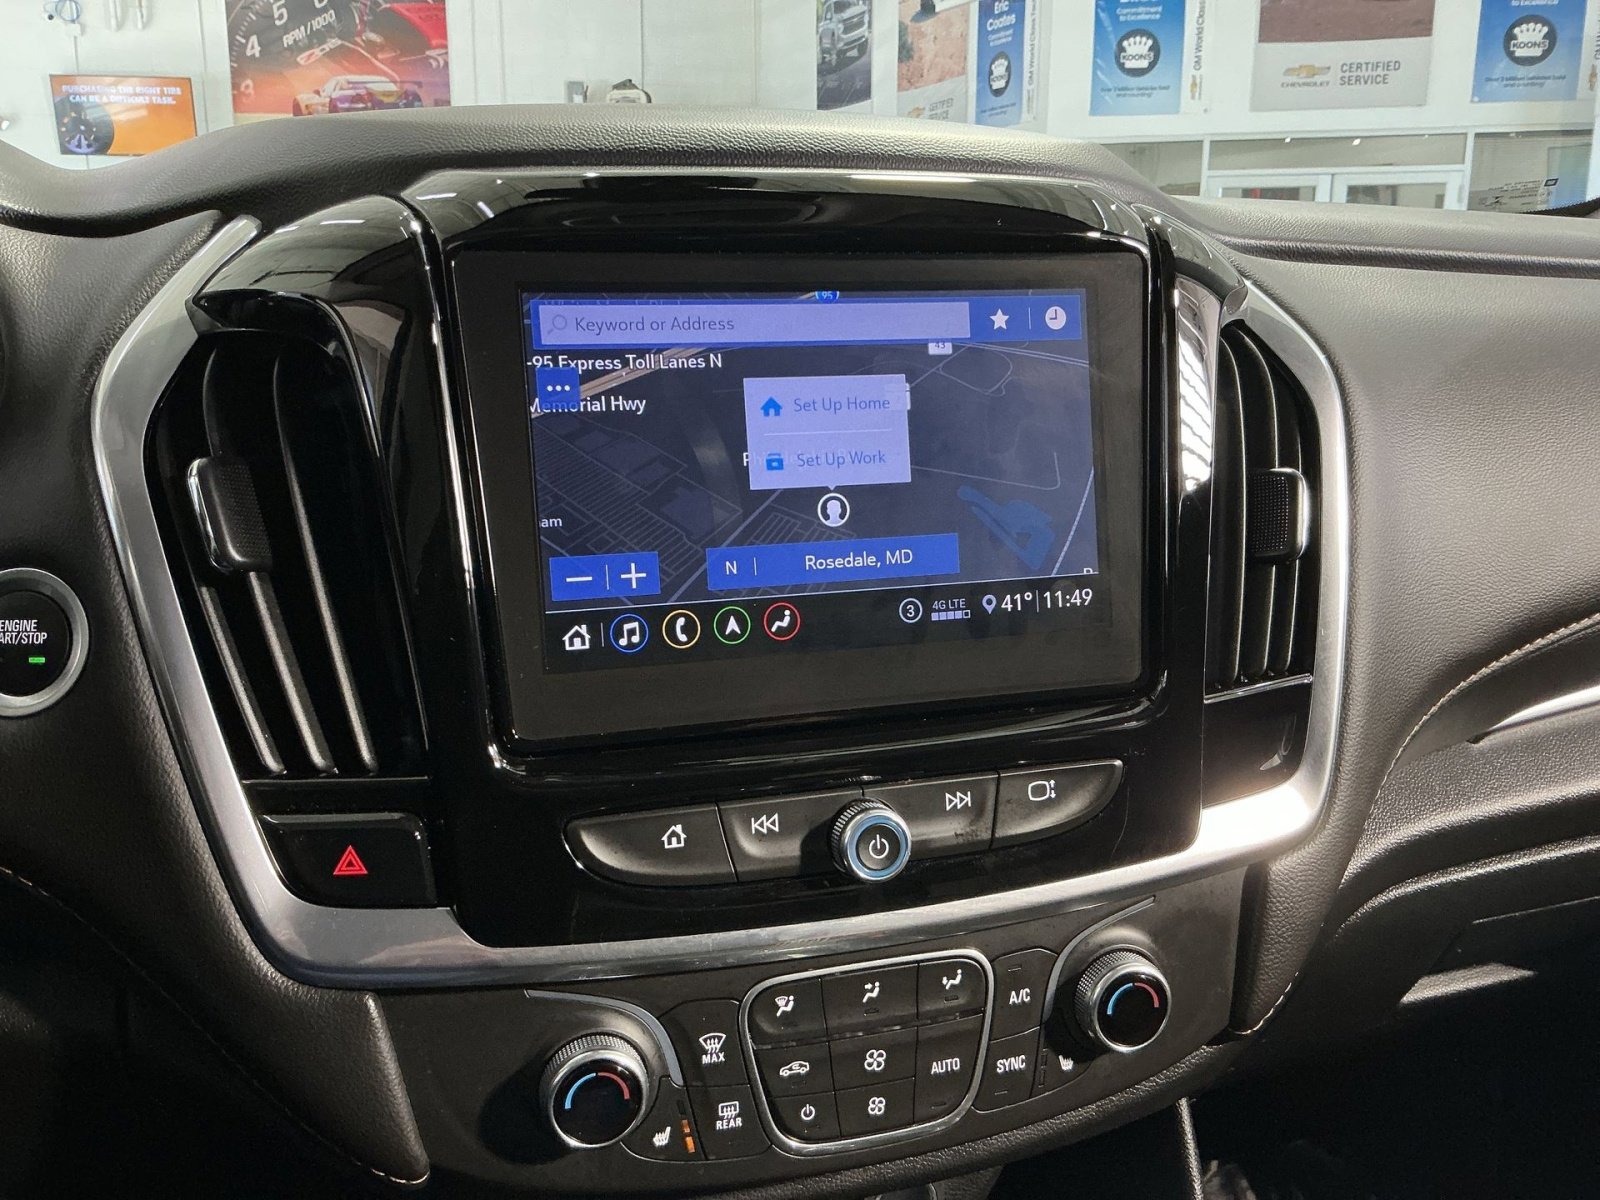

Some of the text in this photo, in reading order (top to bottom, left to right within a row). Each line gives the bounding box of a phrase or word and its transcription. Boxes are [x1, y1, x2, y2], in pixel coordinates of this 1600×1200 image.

[272, 0, 288, 26] 5
[245, 34, 262, 58] 4
[1512, 41, 1548, 49] KOONS
[1340, 60, 1401, 74] CERTIFIED
[1339, 74, 1390, 86] SERVICE
[69, 95, 87, 103] CAN
[135, 86, 161, 95] RIGHT
[575, 315, 734, 336] Keyword or Address
[558, 355, 622, 374] Express
[625, 353, 655, 369] Toll
[659, 354, 706, 369] Lanes
[710, 353, 722, 368] N
[610, 395, 647, 415] Hwy
[793, 396, 890, 415] Set Up Home
[796, 452, 821, 467] Set
[825, 451, 845, 469] Up
[850, 450, 886, 465] Work
[725, 549, 913, 575] N Rosedale, MD
[932, 600, 946, 610] 4G
[949, 598, 966, 609] LTE
[1001, 592, 1033, 612] 41°
[1043, 588, 1093, 609] 11:49
[0, 619, 38, 632] ENGINE
[1008, 988, 1031, 1005] A/C
[701, 1052, 725, 1065] MAX
[930, 1057, 960, 1075] AUTO
[996, 1055, 1026, 1073] SYNC
[716, 1117, 743, 1131] REAR
